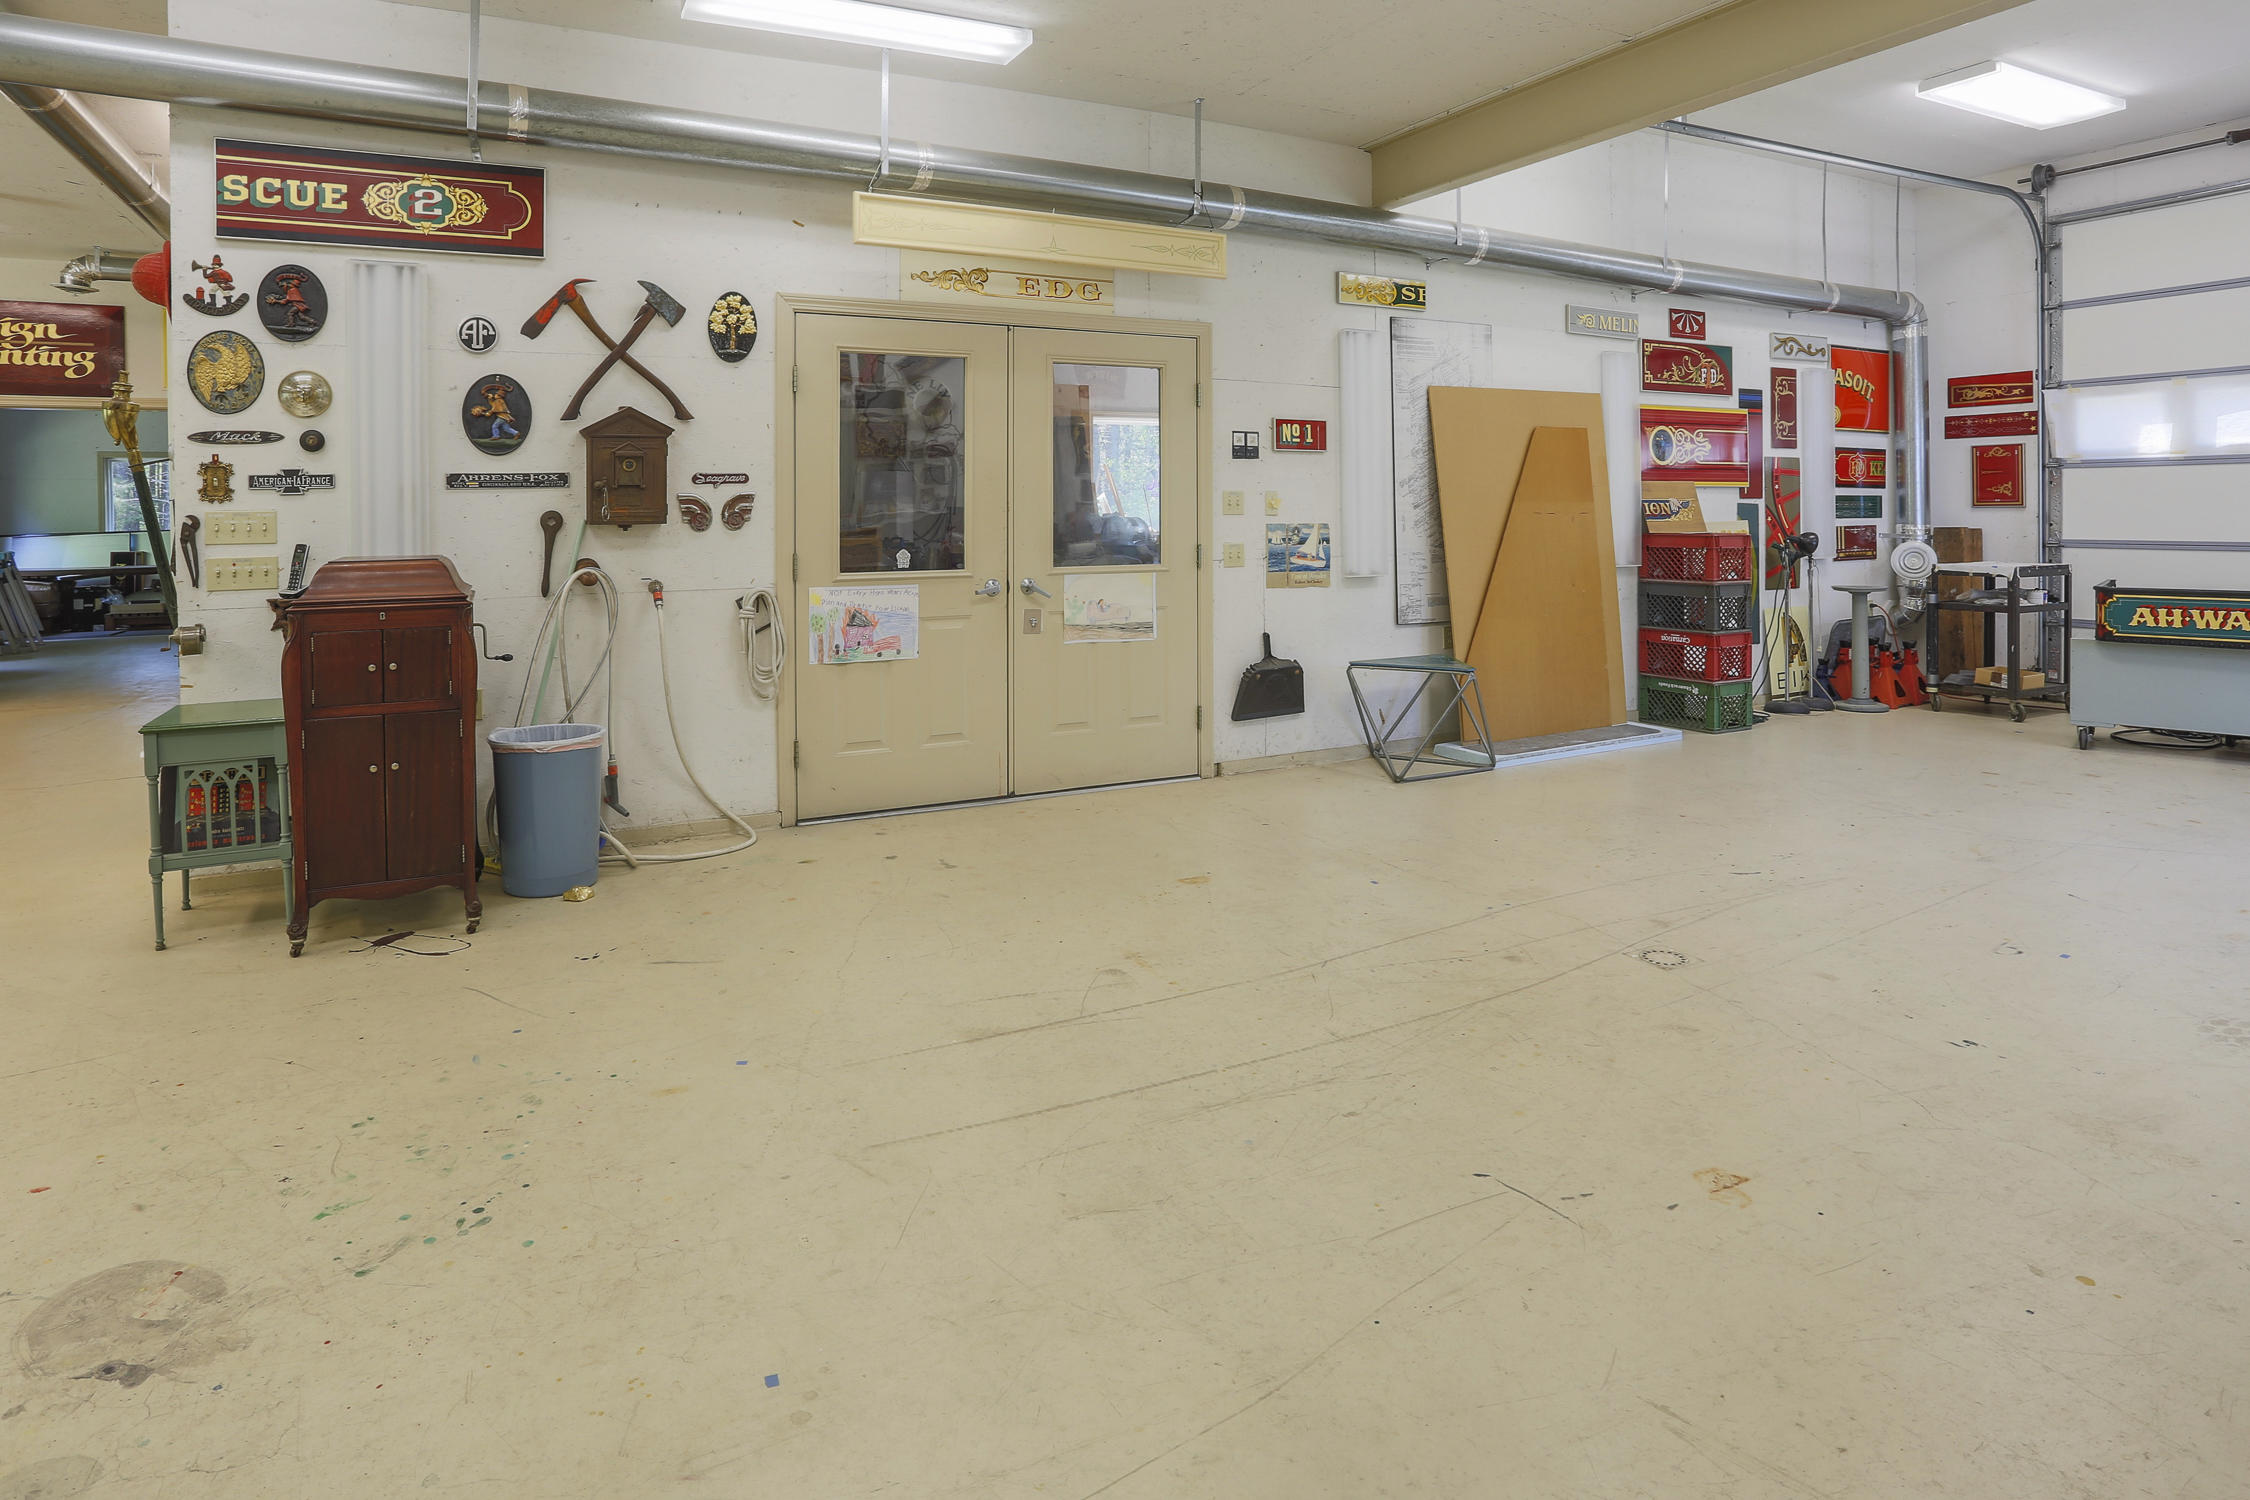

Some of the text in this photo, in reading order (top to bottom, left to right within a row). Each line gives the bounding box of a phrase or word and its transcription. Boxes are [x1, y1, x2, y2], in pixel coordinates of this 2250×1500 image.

[218, 174, 443, 219] SCUE 2
[1016, 277, 1102, 301] EDG
[209, 431, 262, 443] Mack
[1305, 424, 1314, 443] 1
[457, 473, 560, 483] AHRENS-FOX
[695, 472, 747, 489] Seagrave
[1643, 502, 1672, 515] ION
[1661, 634, 1691, 644] Carnation
